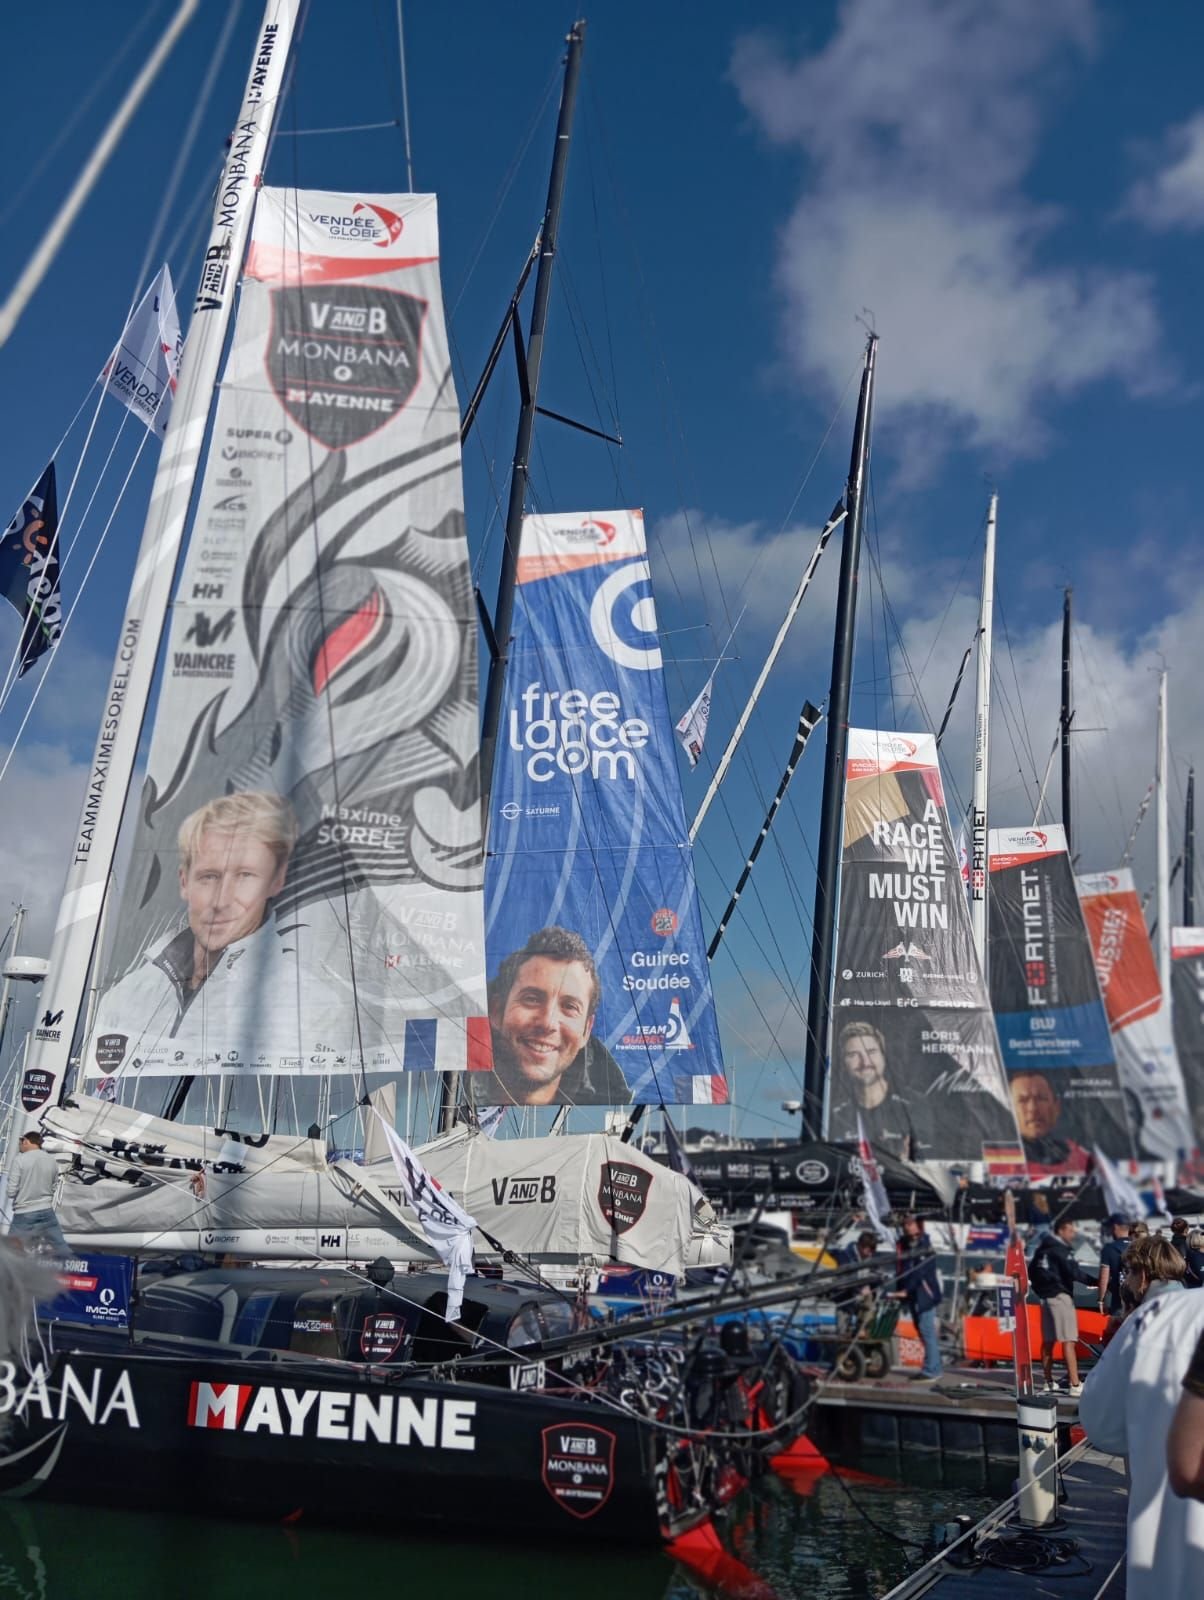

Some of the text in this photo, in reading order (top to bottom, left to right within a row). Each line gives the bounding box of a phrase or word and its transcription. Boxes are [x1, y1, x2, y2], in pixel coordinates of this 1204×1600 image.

[217, 121, 256, 228] MONBANA
[309, 213, 376, 229] VENDÉE
[329, 225, 382, 238] GLOBE
[276, 338, 410, 368] MONBANA
[287, 388, 393, 412] MAYENNE
[174, 652, 235, 670] VAINCRE
[521, 682, 621, 722] free
[74, 618, 142, 866] TEAMMAXIMESOREL.COM
[509, 709, 650, 752] lance
[527, 741, 636, 783] com
[320, 803, 402, 827] Maxime
[923, 798, 940, 823] A
[317, 823, 396, 850] SOREL
[873, 820, 944, 850] RACE
[904, 849, 946, 875] WE
[869, 872, 946, 902] MUST
[893, 901, 948, 929] WIN
[631, 951, 690, 968] Guirec
[622, 973, 691, 992] Soudée
[636, 1025, 667, 1035] TEAM
[921, 1030, 960, 1041] BORIS
[922, 1042, 994, 1054] HERRMANN
[602, 1185, 642, 1204] MNBANA
[85, 1305, 127, 1316] IMOCA
[190, 1380, 477, 1451] MAYENNE
[547, 1459, 609, 1476] MONBANA
